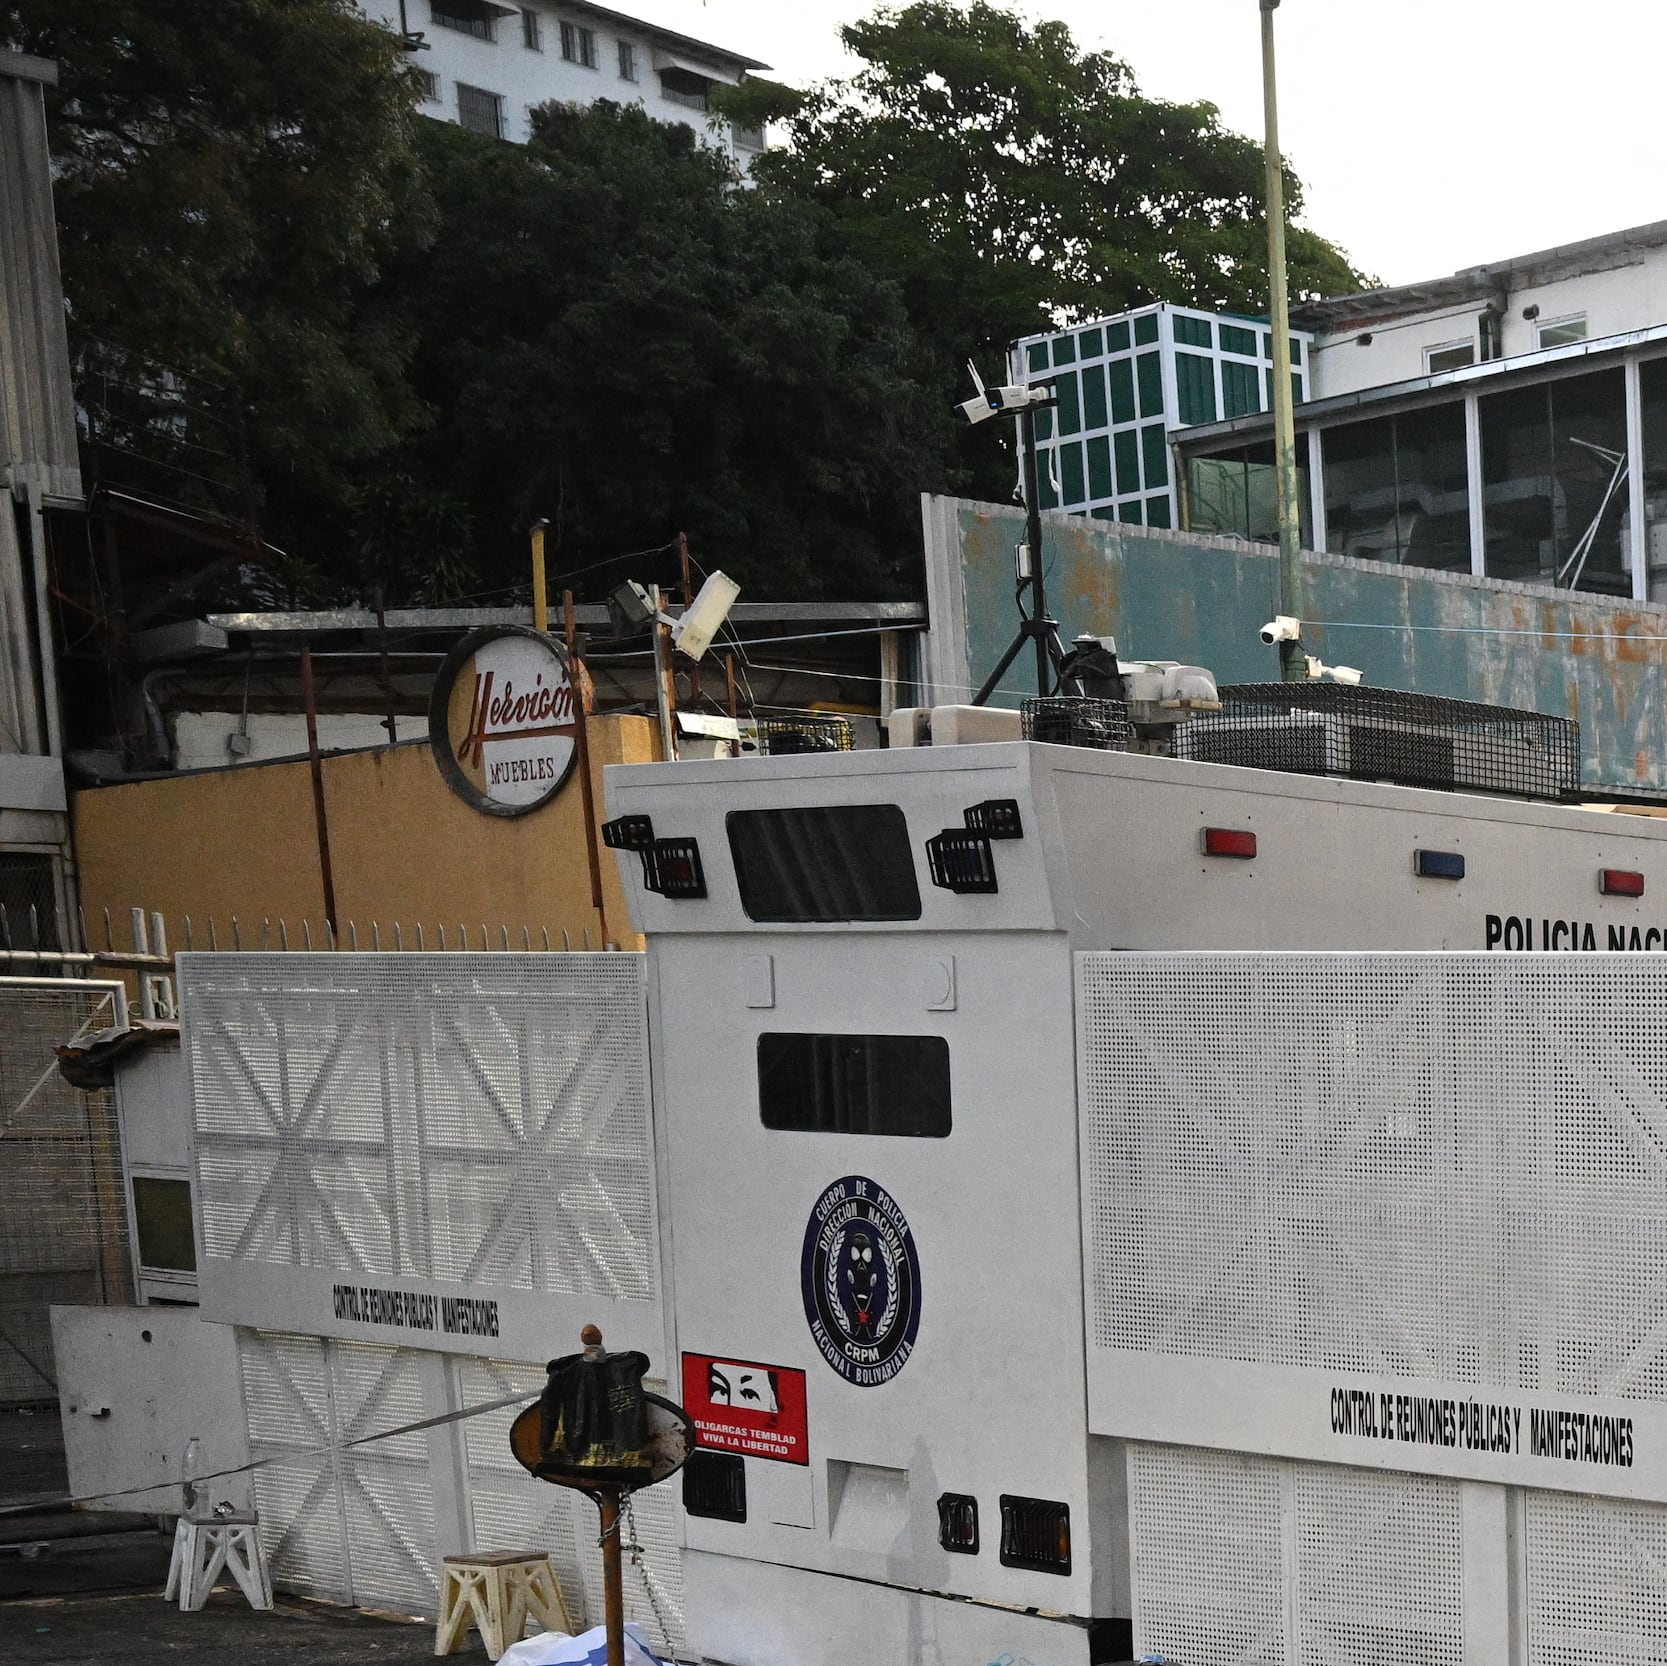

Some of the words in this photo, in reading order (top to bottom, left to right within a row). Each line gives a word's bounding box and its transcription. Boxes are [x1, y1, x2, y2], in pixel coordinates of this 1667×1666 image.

[490, 757, 554, 785] MUEBLES
[1486, 915, 1597, 951] POLICIA
[816, 1184, 846, 1221] CUERPO
[856, 1180, 868, 1196] DE
[819, 1200, 858, 1251] DIRECCIÓN
[868, 1206, 905, 1268] NACIONAL
[811, 1320, 850, 1378] NACIONAL
[855, 1340, 914, 1384] BOLIVARIANA
[845, 1342, 880, 1362] CRPM
[694, 1420, 748, 1436] OLIGARCAS
[750, 1429, 797, 1444] TEMBLAD
[703, 1432, 725, 1444] VIVA
[727, 1437, 740, 1446] LA
[742, 1440, 789, 1454] LIBERTAD
[1331, 1387, 1378, 1438] CONTROL
[1380, 1393, 1394, 1440] DE
[1397, 1395, 1456, 1448] REUNIONES
[1459, 1395, 1511, 1454] PÚBLICAS
[1513, 1407, 1521, 1454] Y
[1530, 1408, 1633, 1468] MANIFESTACIONES
